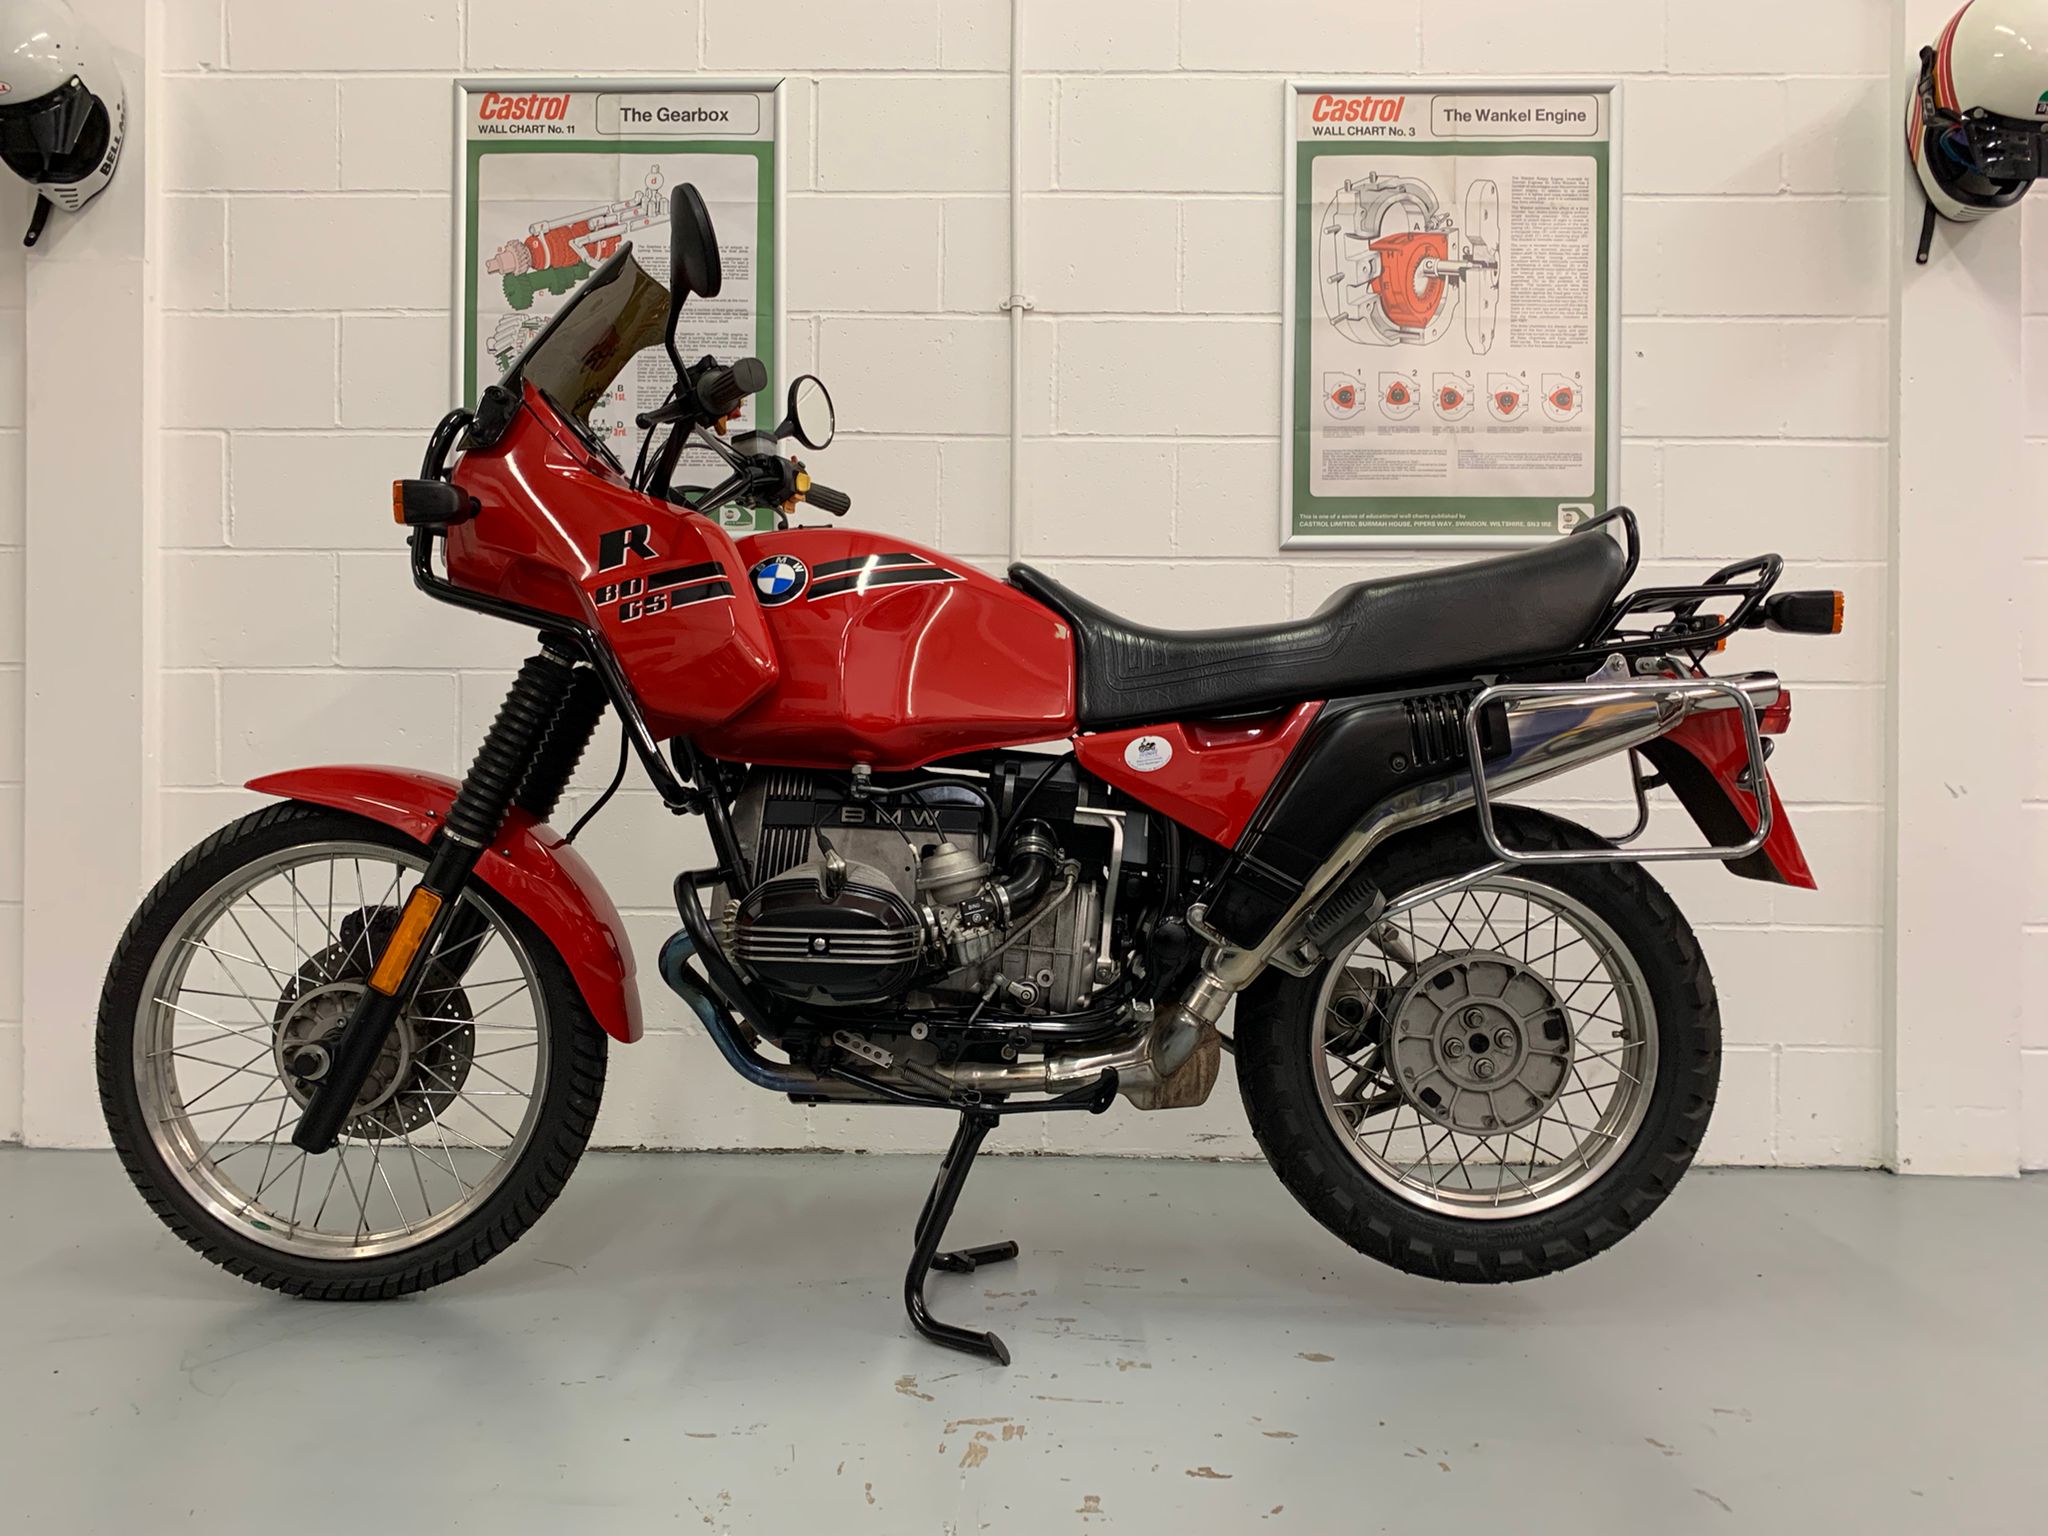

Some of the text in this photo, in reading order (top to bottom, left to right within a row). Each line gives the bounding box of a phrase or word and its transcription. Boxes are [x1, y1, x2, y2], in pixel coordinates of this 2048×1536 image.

[479, 92, 571, 120] Castrol
[1312, 94, 1405, 122] Castrol
[620, 107, 729, 122] The Gearbox
[1443, 108, 1587, 124] The Wankel Engine
[478, 125, 575, 134] WALL CHART No. 11
[1312, 126, 1416, 137] WALL CHART No. 3
[99, 135, 121, 176] BELL
[1413, 222, 1421, 231] A
[1425, 260, 1433, 269] C
[1356, 368, 1361, 376] 1
[1412, 369, 1418, 377] 2
[1465, 370, 1471, 378] 3
[1520, 370, 1526, 378] 4
[1574, 371, 1581, 379] 5
[599, 524, 659, 574] R
[756, 556, 805, 572] BMW
[596, 577, 643, 607] 80
[619, 593, 667, 623] GS
[841, 806, 940, 826] BMW
